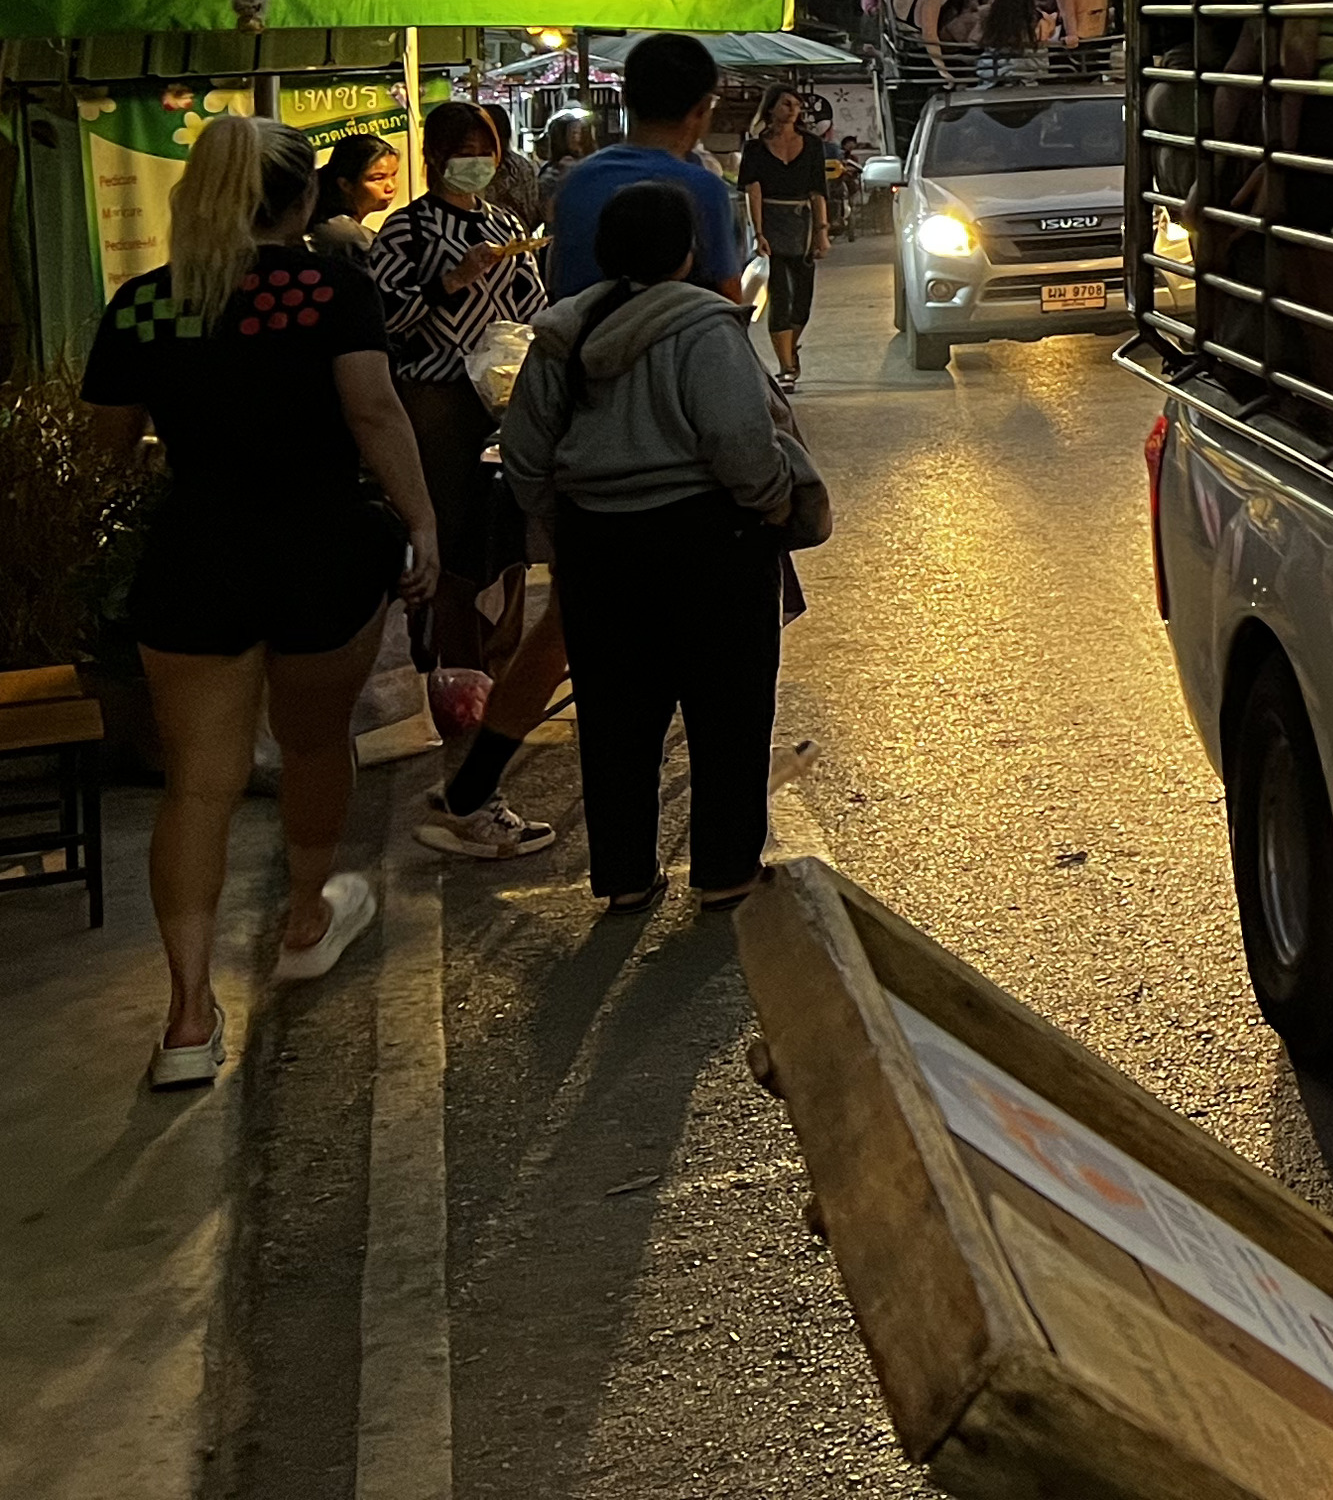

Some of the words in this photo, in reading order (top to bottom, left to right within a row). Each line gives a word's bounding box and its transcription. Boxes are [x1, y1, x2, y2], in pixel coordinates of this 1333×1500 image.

[294, 84, 378, 112] เพชร
[1041, 216, 1099, 230] ISUZU
[1073, 285, 1102, 297] 9708
